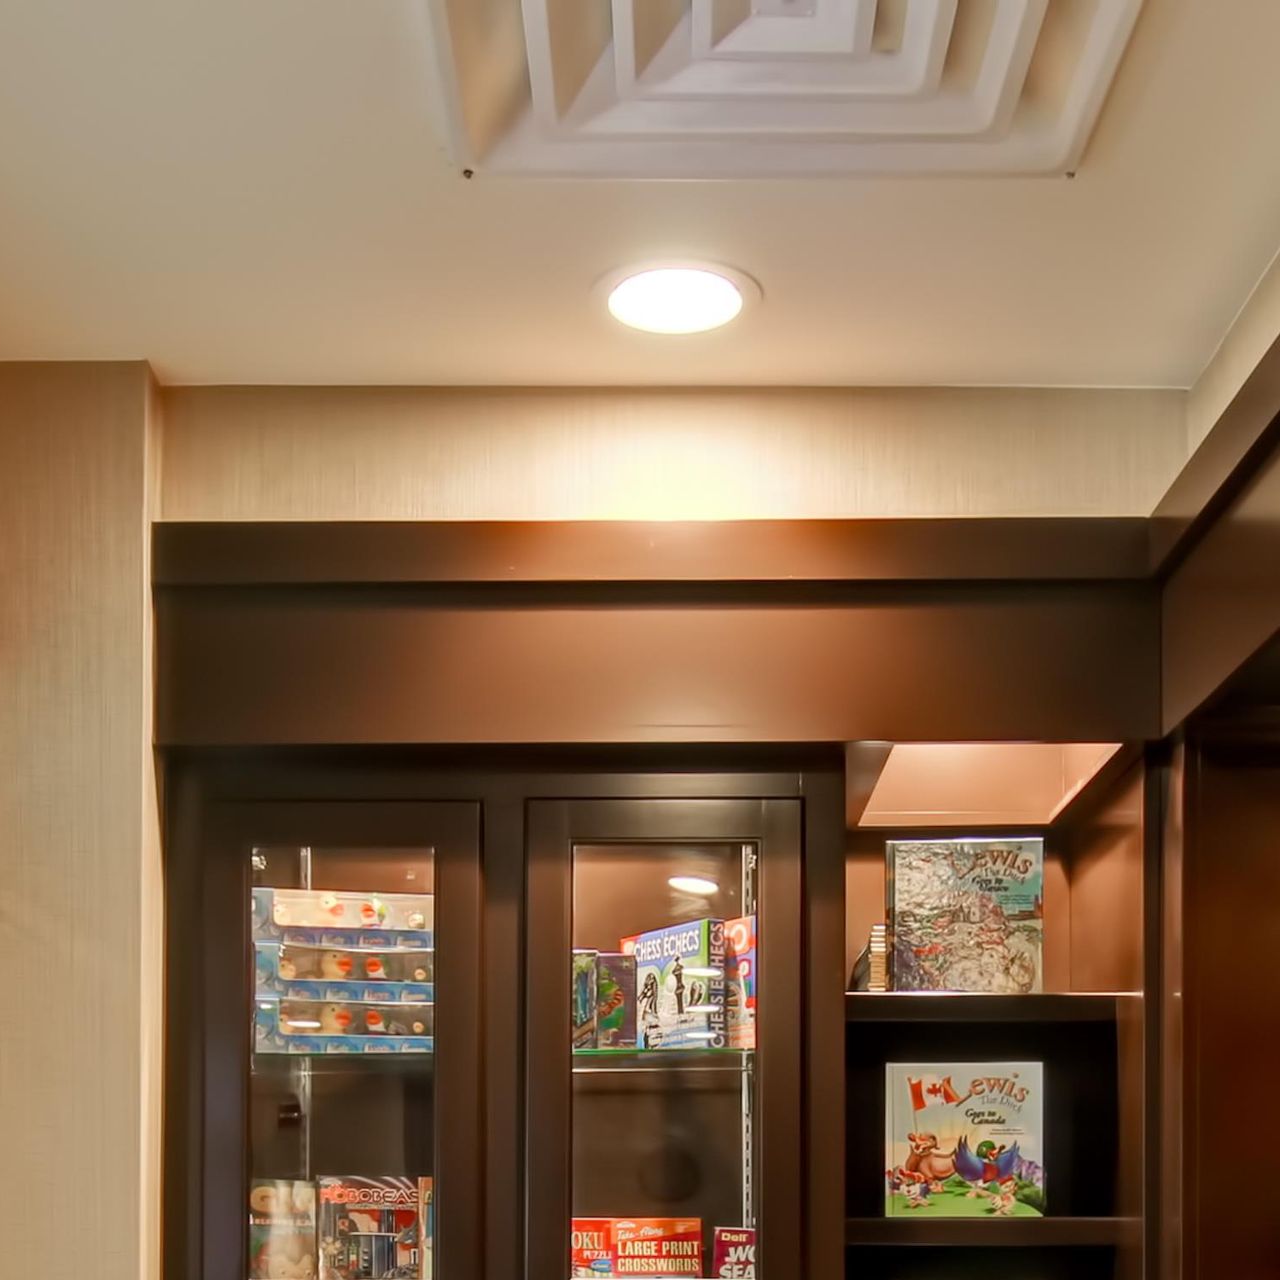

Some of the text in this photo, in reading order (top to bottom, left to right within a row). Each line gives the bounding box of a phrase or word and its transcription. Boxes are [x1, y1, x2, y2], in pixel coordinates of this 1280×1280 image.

[635, 938, 662, 962] CHESS
[572, 1231, 604, 1250] OKU
[618, 1241, 700, 1257] LARGE PRINT
[618, 1258, 700, 1273] CROSSWORDS
